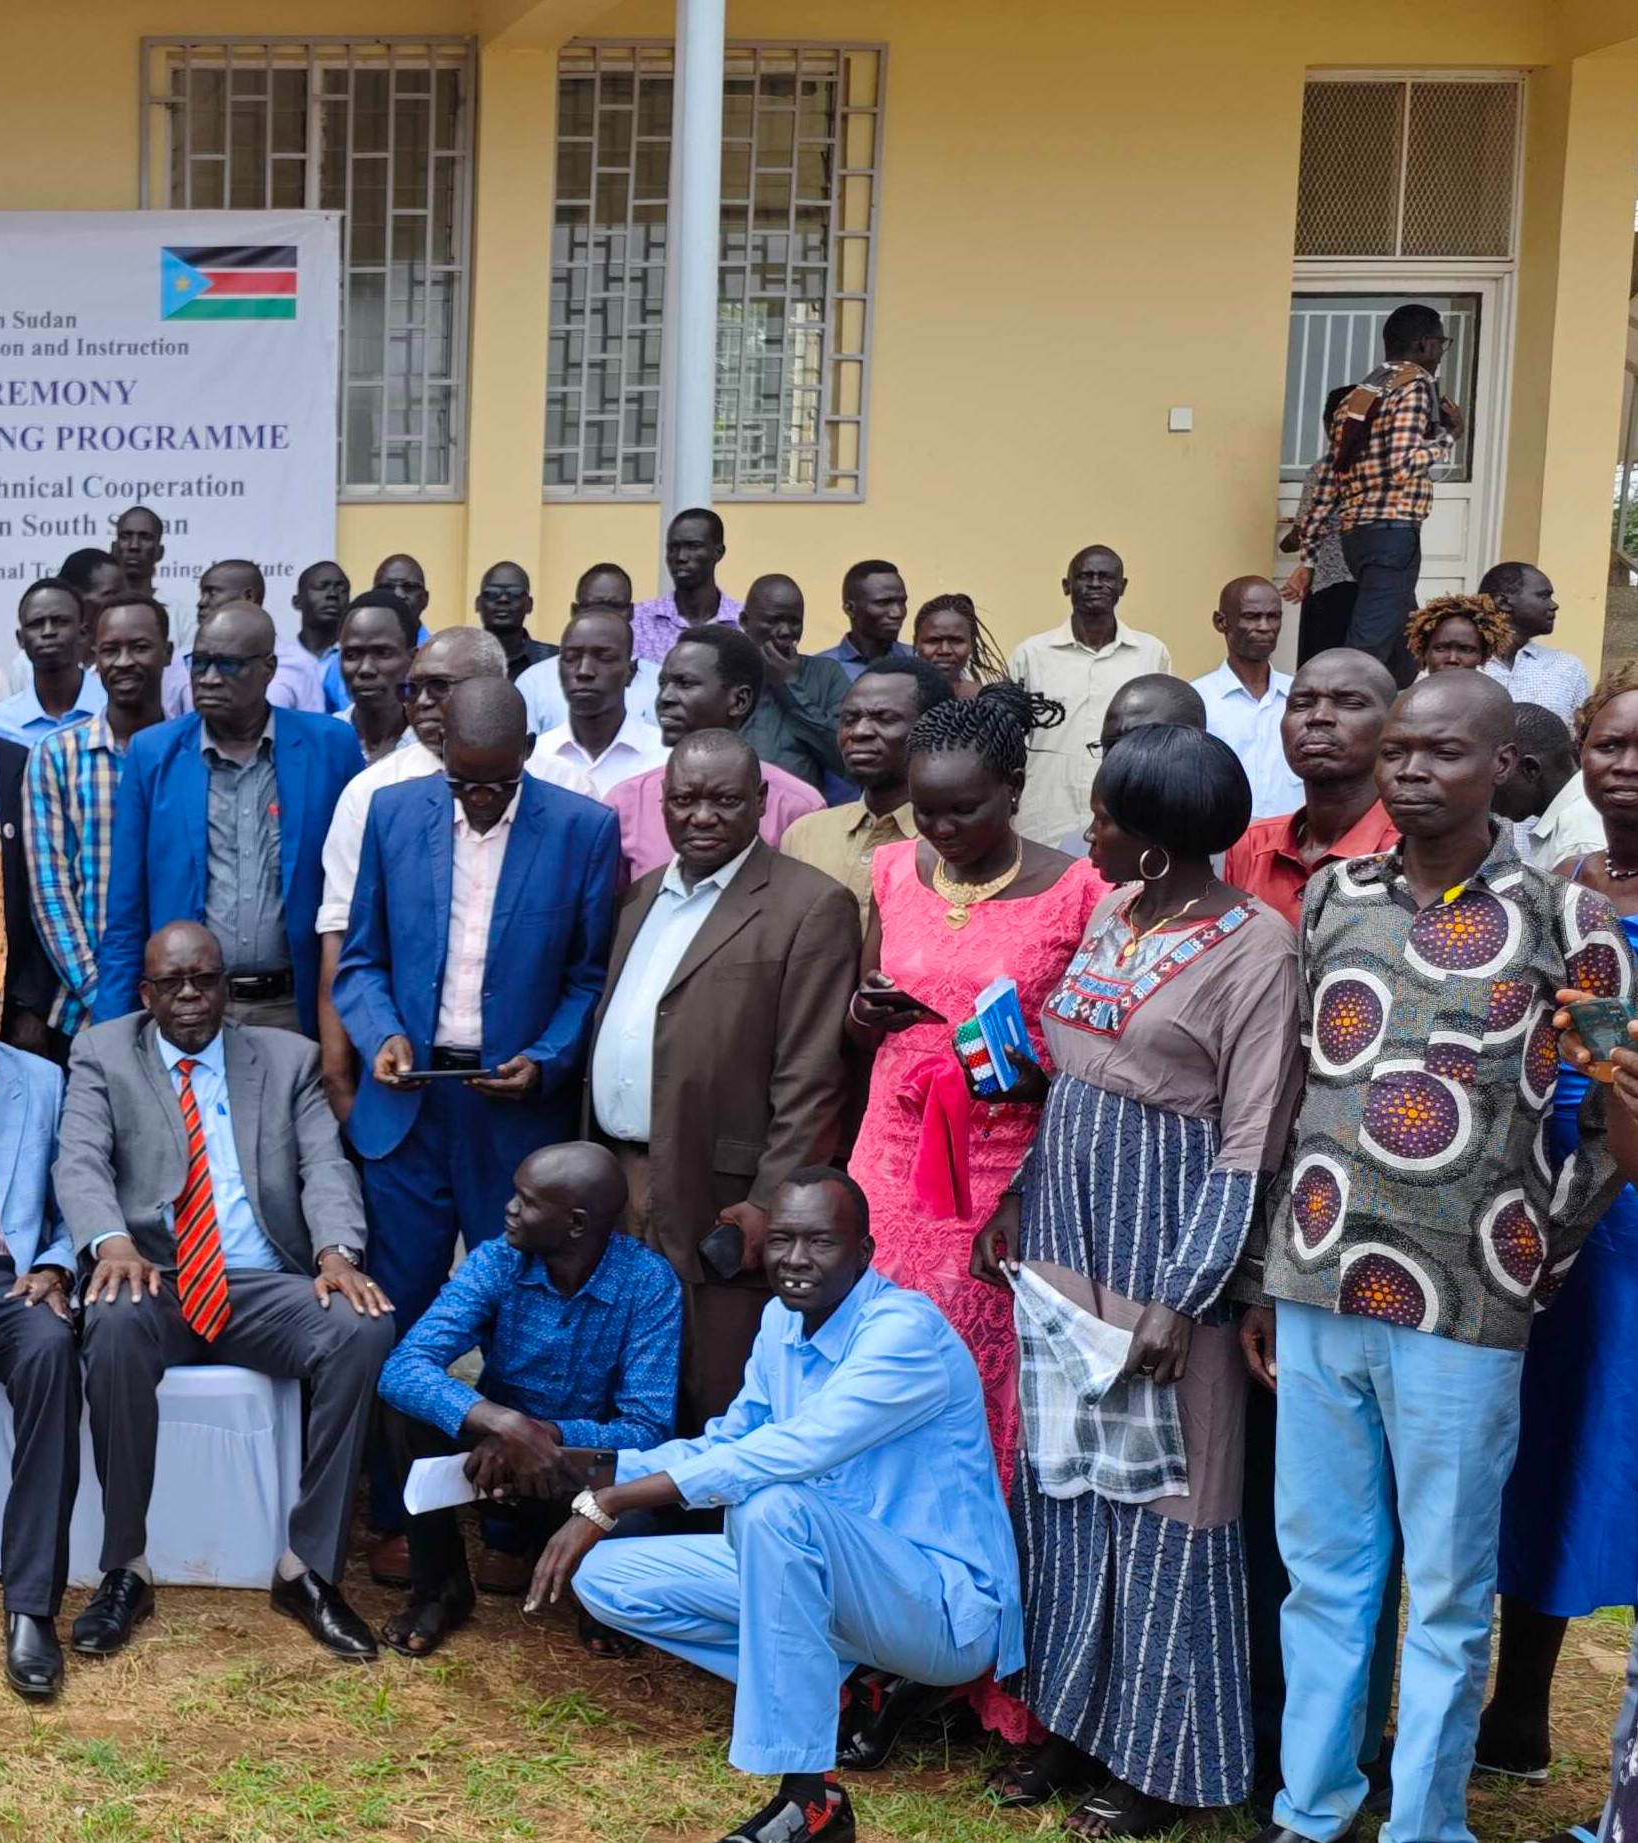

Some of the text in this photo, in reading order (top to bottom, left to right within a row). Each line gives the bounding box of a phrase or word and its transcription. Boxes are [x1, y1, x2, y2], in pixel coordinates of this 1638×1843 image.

[13, 310, 77, 329] Sudan
[32, 338, 69, 356] and
[77, 338, 190, 356] Instruction
[56, 424, 290, 451] PROGRAMME
[82, 474, 245, 506] Cooperation
[22, 513, 98, 537] South
[106, 513, 188, 535] San
